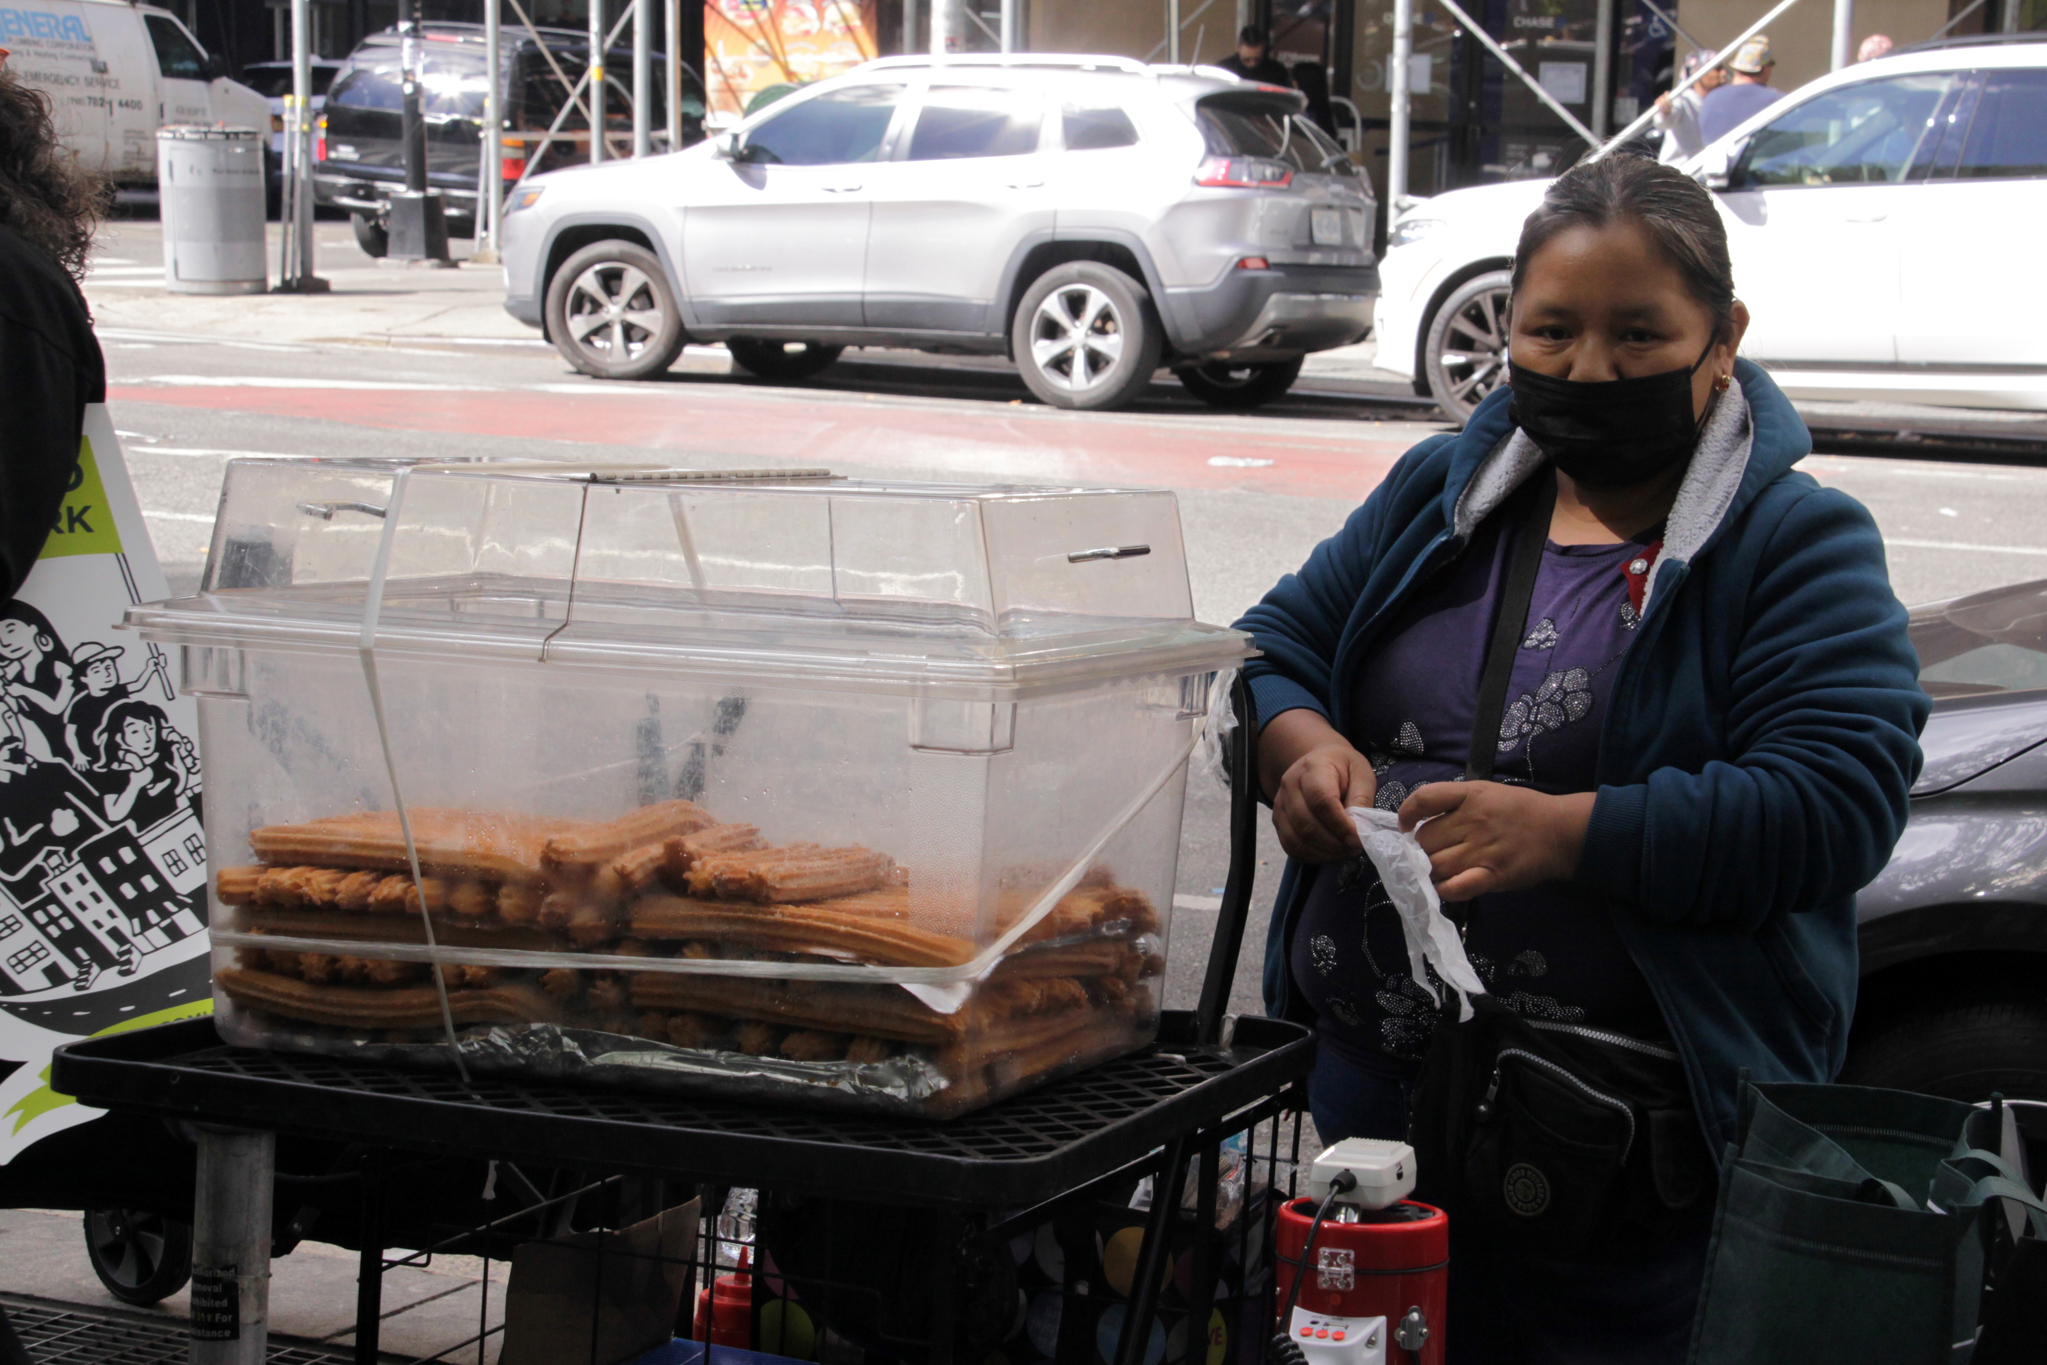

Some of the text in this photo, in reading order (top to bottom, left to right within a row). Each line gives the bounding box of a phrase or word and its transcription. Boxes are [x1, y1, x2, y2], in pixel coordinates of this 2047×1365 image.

[0, 8, 92, 43] ENERAL
[1513, 15, 1555, 29] CHASE
[23, 70, 120, 89] EMERGENCY SERVICE
[215, 1312, 233, 1323] For
